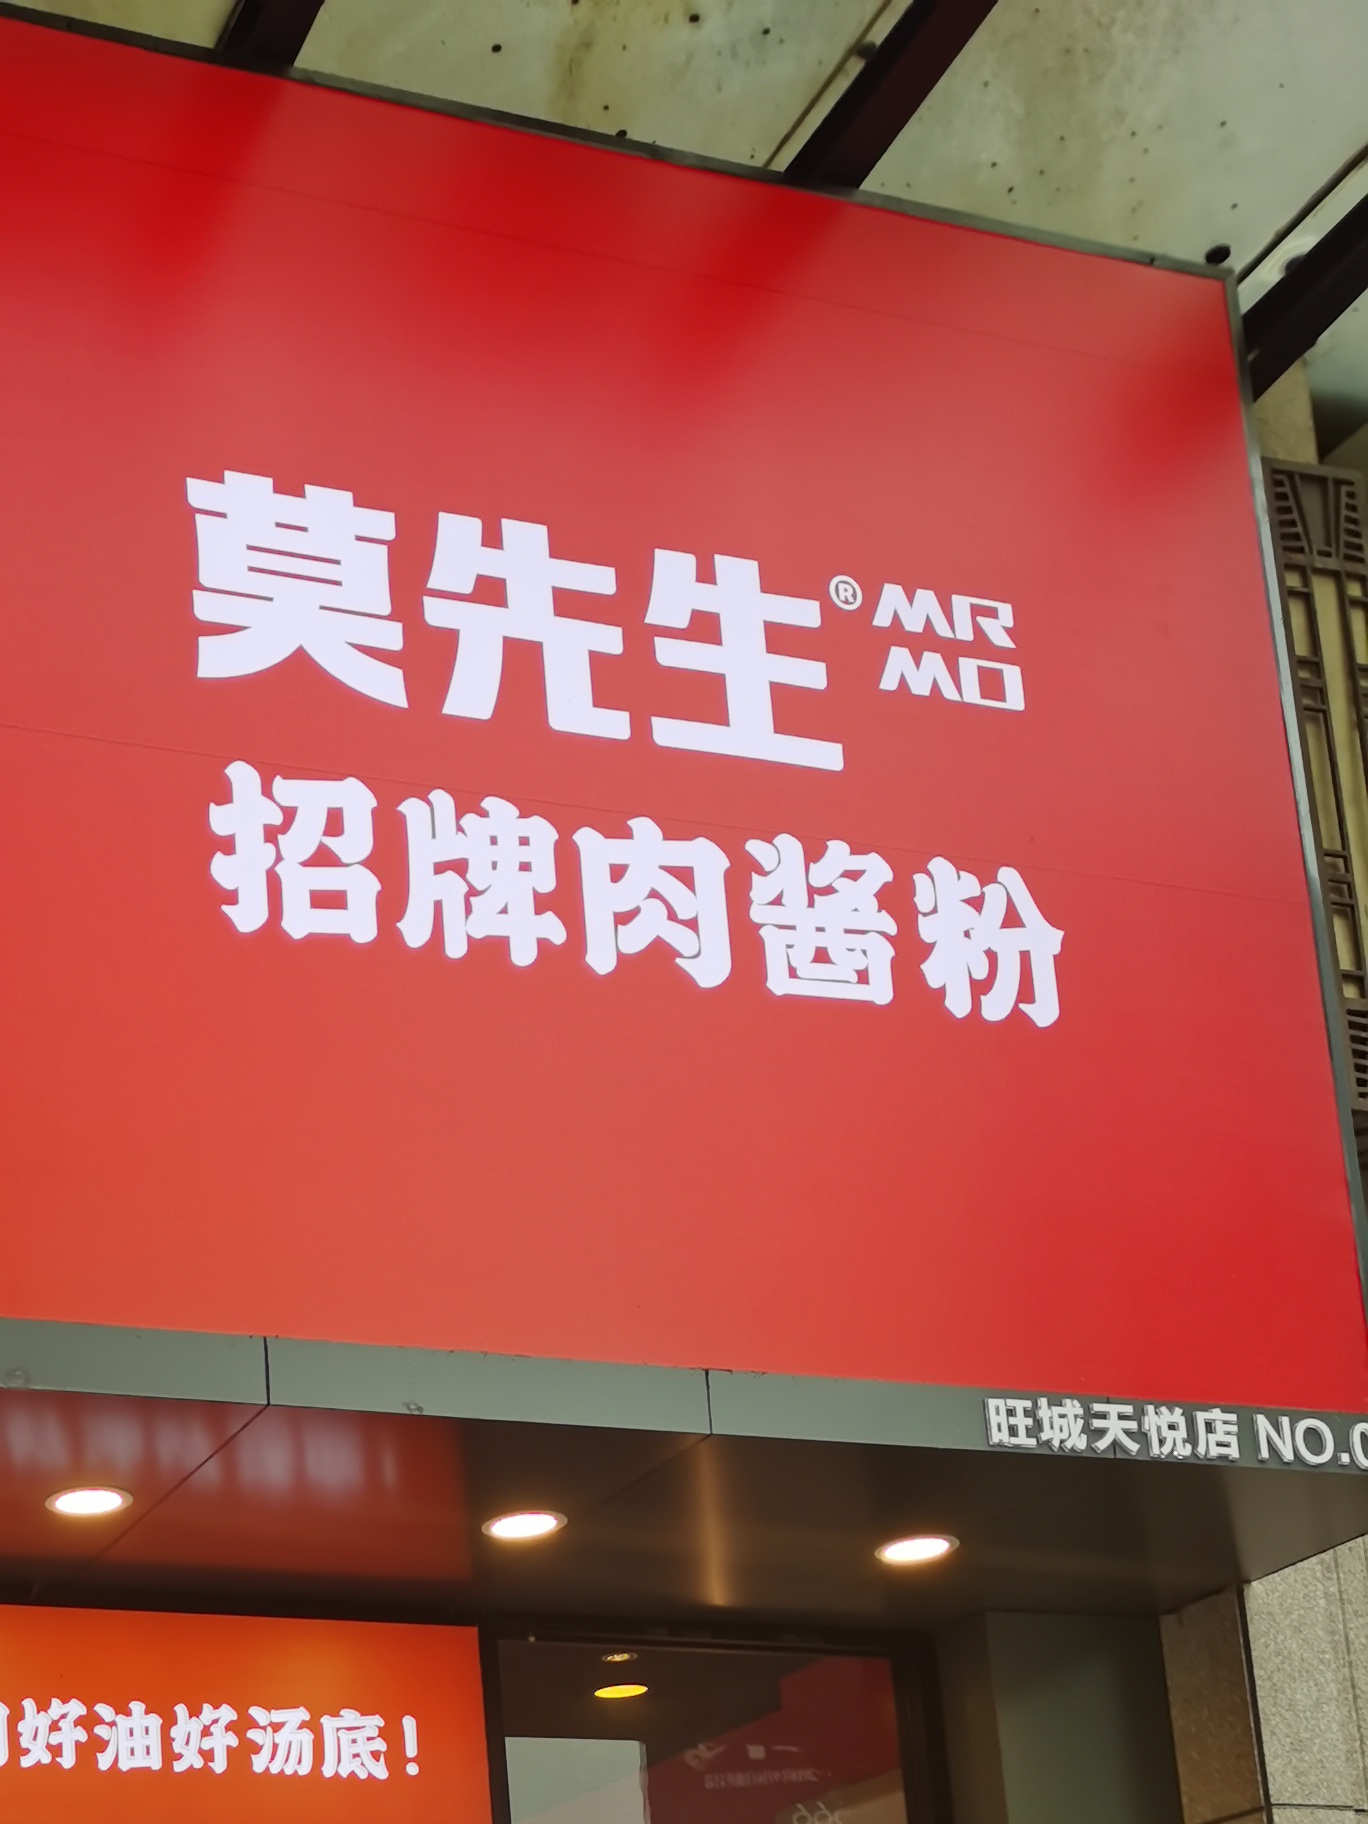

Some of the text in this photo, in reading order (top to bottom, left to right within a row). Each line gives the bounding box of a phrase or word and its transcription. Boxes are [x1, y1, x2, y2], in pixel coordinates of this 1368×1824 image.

[186, 470, 844, 771] 莫先生
[872, 583, 1016, 649] MR
[879, 647, 1025, 711] MO
[208, 761, 1064, 1027] 招牌肉酱粉
[983, 1397, 1240, 1460] 旺城天悦店
